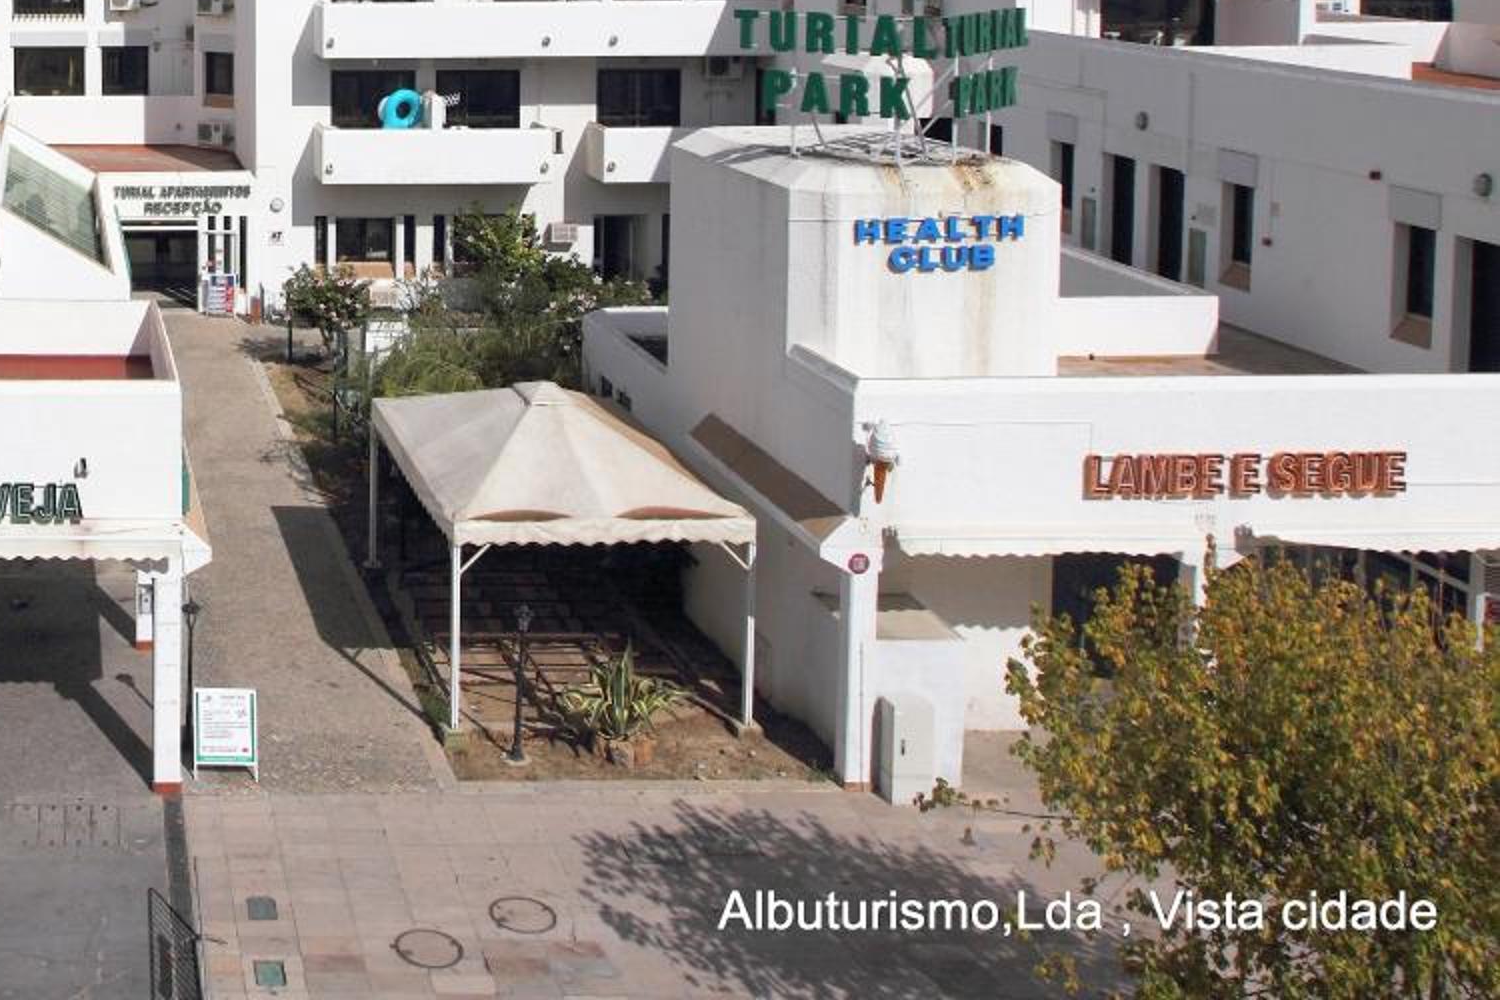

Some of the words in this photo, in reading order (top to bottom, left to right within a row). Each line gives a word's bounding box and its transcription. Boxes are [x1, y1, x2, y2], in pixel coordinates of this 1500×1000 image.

[734, 9, 937, 60] TURIAL
[942, 7, 1028, 58] TURIAL
[762, 68, 911, 121] PARK
[950, 66, 1018, 118] PARK
[143, 199, 222, 217] RECEPÇÃO
[854, 214, 1025, 245] HEALTH
[888, 244, 995, 274] CLUB
[1082, 453, 1225, 500] LAMBE
[1229, 453, 1261, 500] E
[1267, 451, 1407, 500] SEGUE
